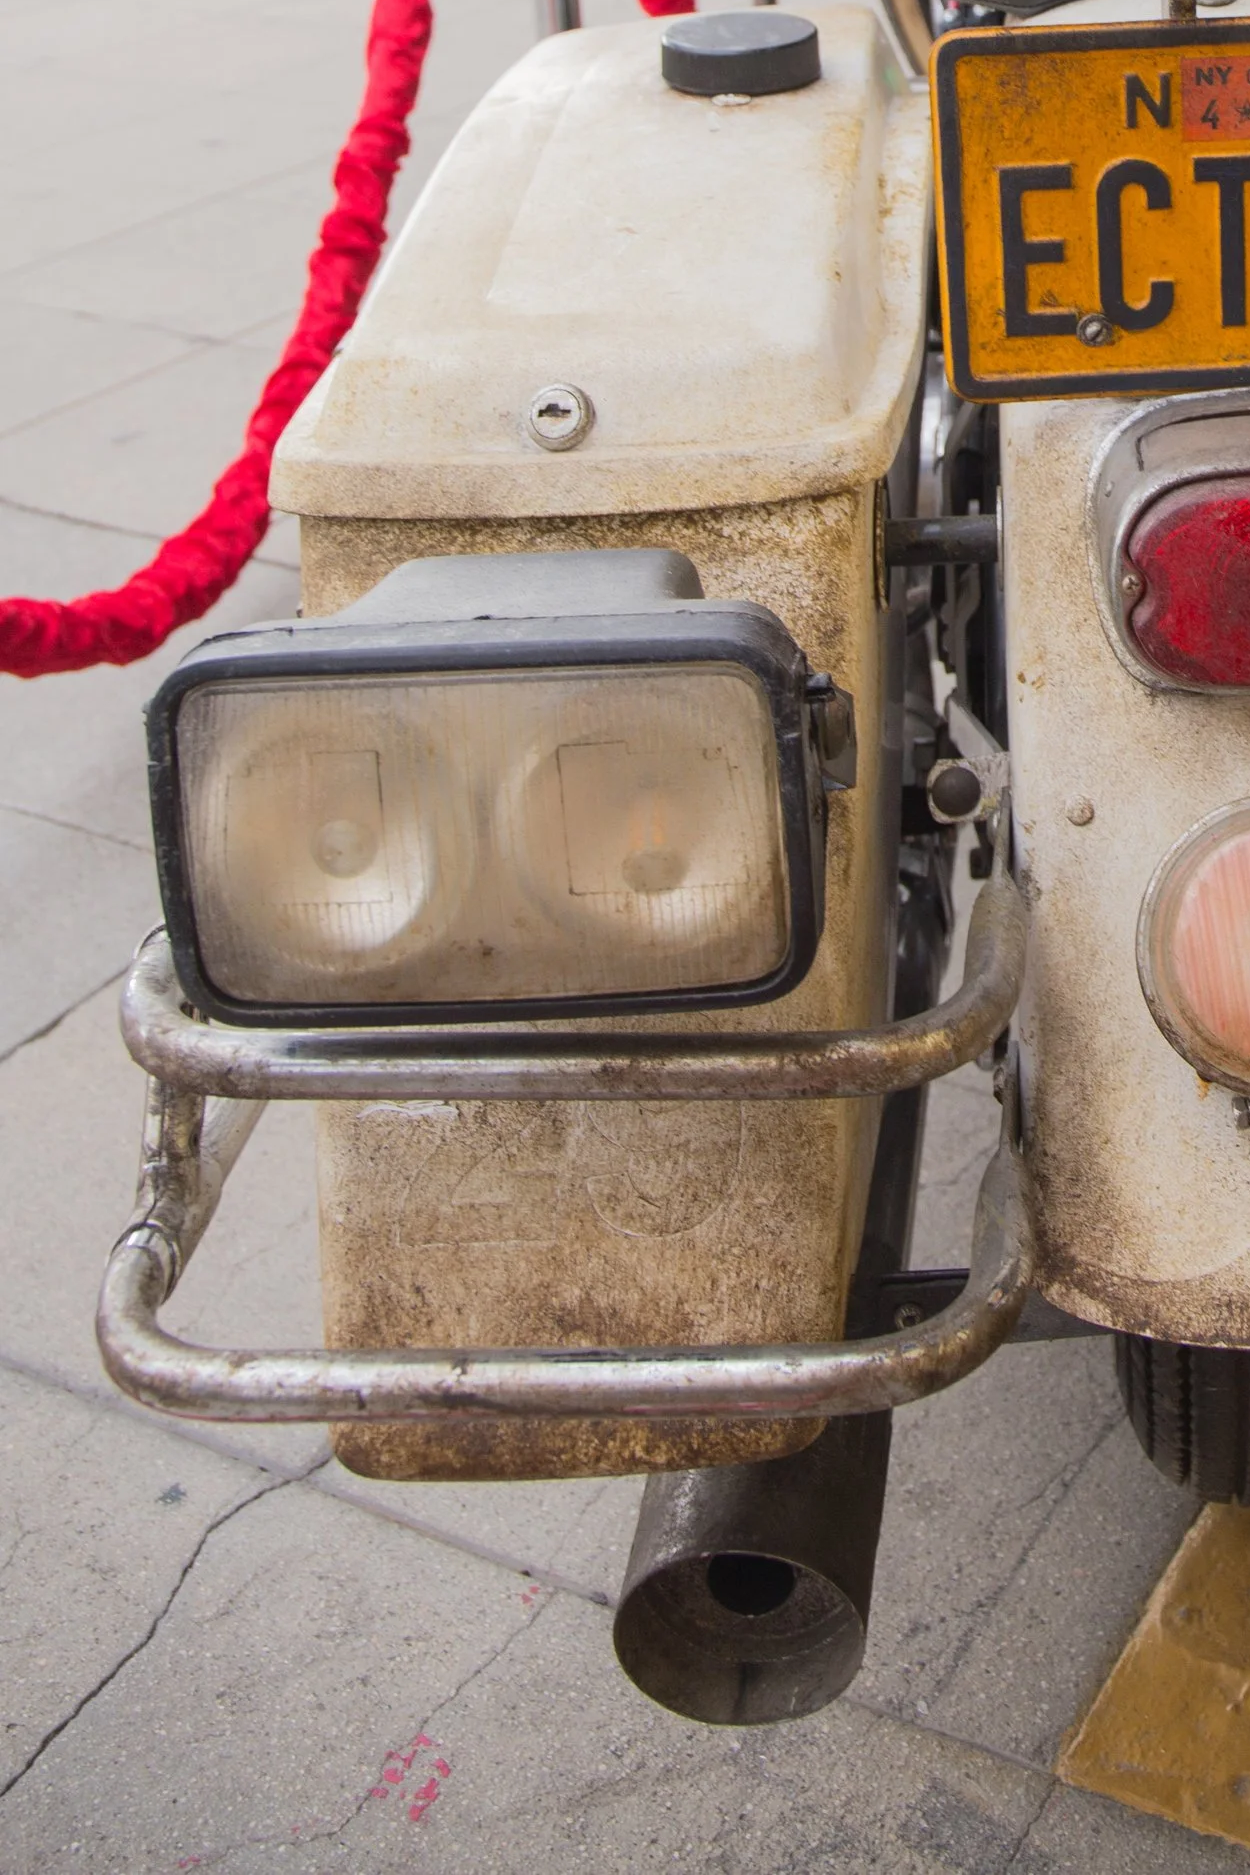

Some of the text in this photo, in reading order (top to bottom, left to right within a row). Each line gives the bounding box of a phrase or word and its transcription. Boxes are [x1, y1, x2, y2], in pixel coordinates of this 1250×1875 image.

[1194, 66, 1233, 87] NY
[1124, 71, 1172, 129] N
[1200, 99, 1220, 130] 4
